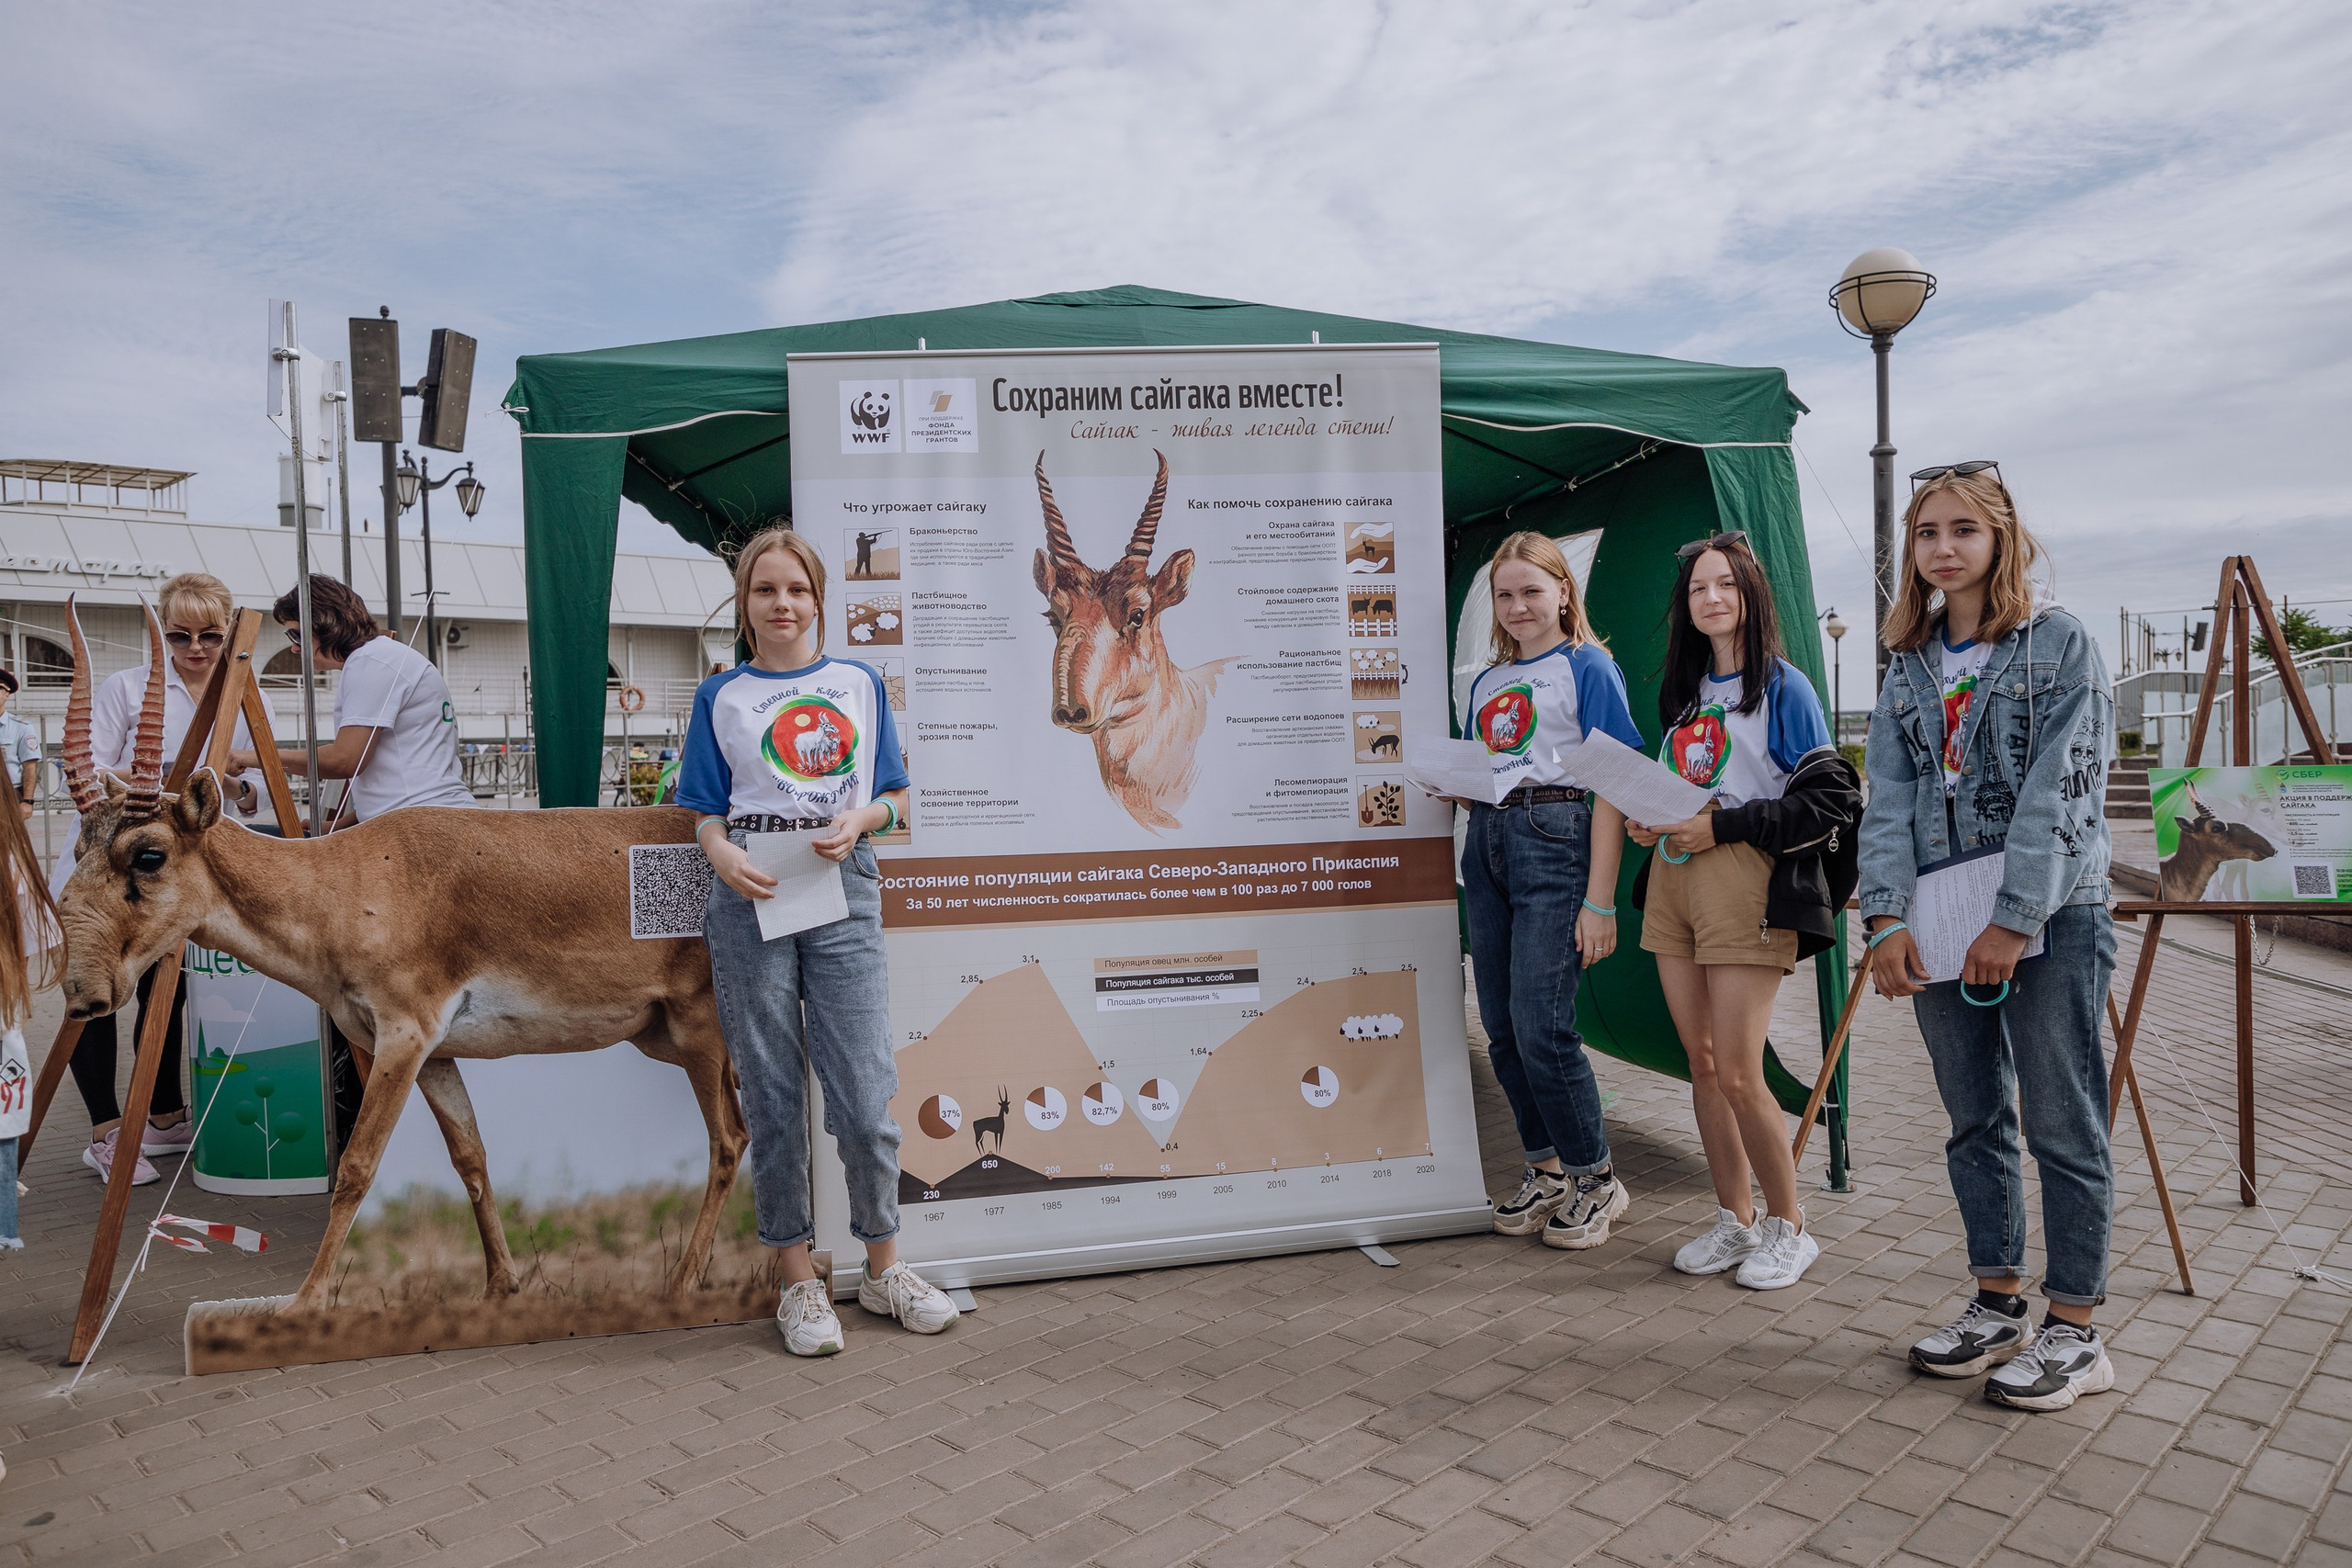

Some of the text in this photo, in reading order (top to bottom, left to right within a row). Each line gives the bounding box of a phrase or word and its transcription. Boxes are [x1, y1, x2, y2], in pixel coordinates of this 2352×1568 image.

[992, 373, 1341, 417] Сохраним сайгака вместе!
[1070, 417, 1139, 439] Сайгак
[1172, 417, 1234, 437] живая
[1245, 416, 1316, 435] легенда
[1329, 415, 1393, 434] степи!
[852, 433, 889, 443] WWF
[1188, 496, 1392, 509] Как помочь сохранению сайгака
[843, 501, 986, 514] Что угрожает сайгаку
[1268, 521, 1299, 530] Охрана
[910, 527, 978, 536] Браконьерство
[1269, 530, 1335, 538] местообитаний
[911, 591, 967, 599] Пастбищное
[1238, 586, 1338, 595] Стойловое содержание
[1265, 597, 1314, 605] домашнего
[1279, 649, 1340, 658] Рациональное
[1305, 659, 1341, 667] пастбищ
[915, 667, 987, 676] Опустынивание
[752, 686, 850, 714] Степной клуб
[1226, 716, 1279, 724] Расширение
[1303, 713, 1344, 721] водопоев
[2291, 770, 2323, 778] СБЕР
[1274, 777, 1347, 785] Лесомелиорация
[920, 788, 989, 796] Хозяйственное
[1273, 788, 1348, 797] фитомелиорация
[966, 799, 1018, 807] территории
[2052, 827, 2076, 850] OMG
[876, 856, 1398, 889] Состояние популяции сайгака Северо-Западного Прикаспия
[906, 879, 1371, 908] За 50 лет численность сократилась более чем в 100 раз до 7 000 голов
[1023, 953, 1035, 964] 3,1
[1104, 959, 1149, 968] Популяция
[1193, 954, 1222, 963] особей
[1351, 967, 1364, 976] 2,5
[1400, 964, 1413, 972] 2,5
[961, 974, 979, 984] 2,85
[1105, 978, 1151, 988] Популяция
[1152, 976, 1184, 985] сайгака
[1204, 972, 1234, 982] особей
[1296, 976, 1309, 986] 2,4
[1148, 994, 1209, 1005] опустынивания
[1241, 1010, 1259, 1019] 2,25
[909, 1031, 922, 1041] 2,2
[1190, 1047, 1207, 1056] 1,64
[1102, 1060, 1115, 1069] 1,5
[1314, 1089, 1331, 1099] 80%
[1091, 1106, 1117, 1116] 82,7%
[1151, 1102, 1170, 1111] 80%
[941, 1110, 960, 1119] 37%
[1041, 1111, 1058, 1121] 83%
[1166, 1143, 1178, 1152] 0,4
[1376, 1147, 1382, 1156] 6
[1424, 1143, 1430, 1151] 7
[1324, 1152, 1330, 1160] 3
[981, 1160, 998, 1169] 650
[1215, 1162, 1226, 1170] 15
[1271, 1157, 1277, 1166] 8
[1045, 1166, 1061, 1175] 200
[1098, 1163, 1114, 1172] 142
[1159, 1164, 1170, 1173] 55
[923, 1190, 940, 1200] 230
[924, 1164, 1435, 1222] 1967 1977 1985 1994 1999 2005 2010 2014 2018 2020
